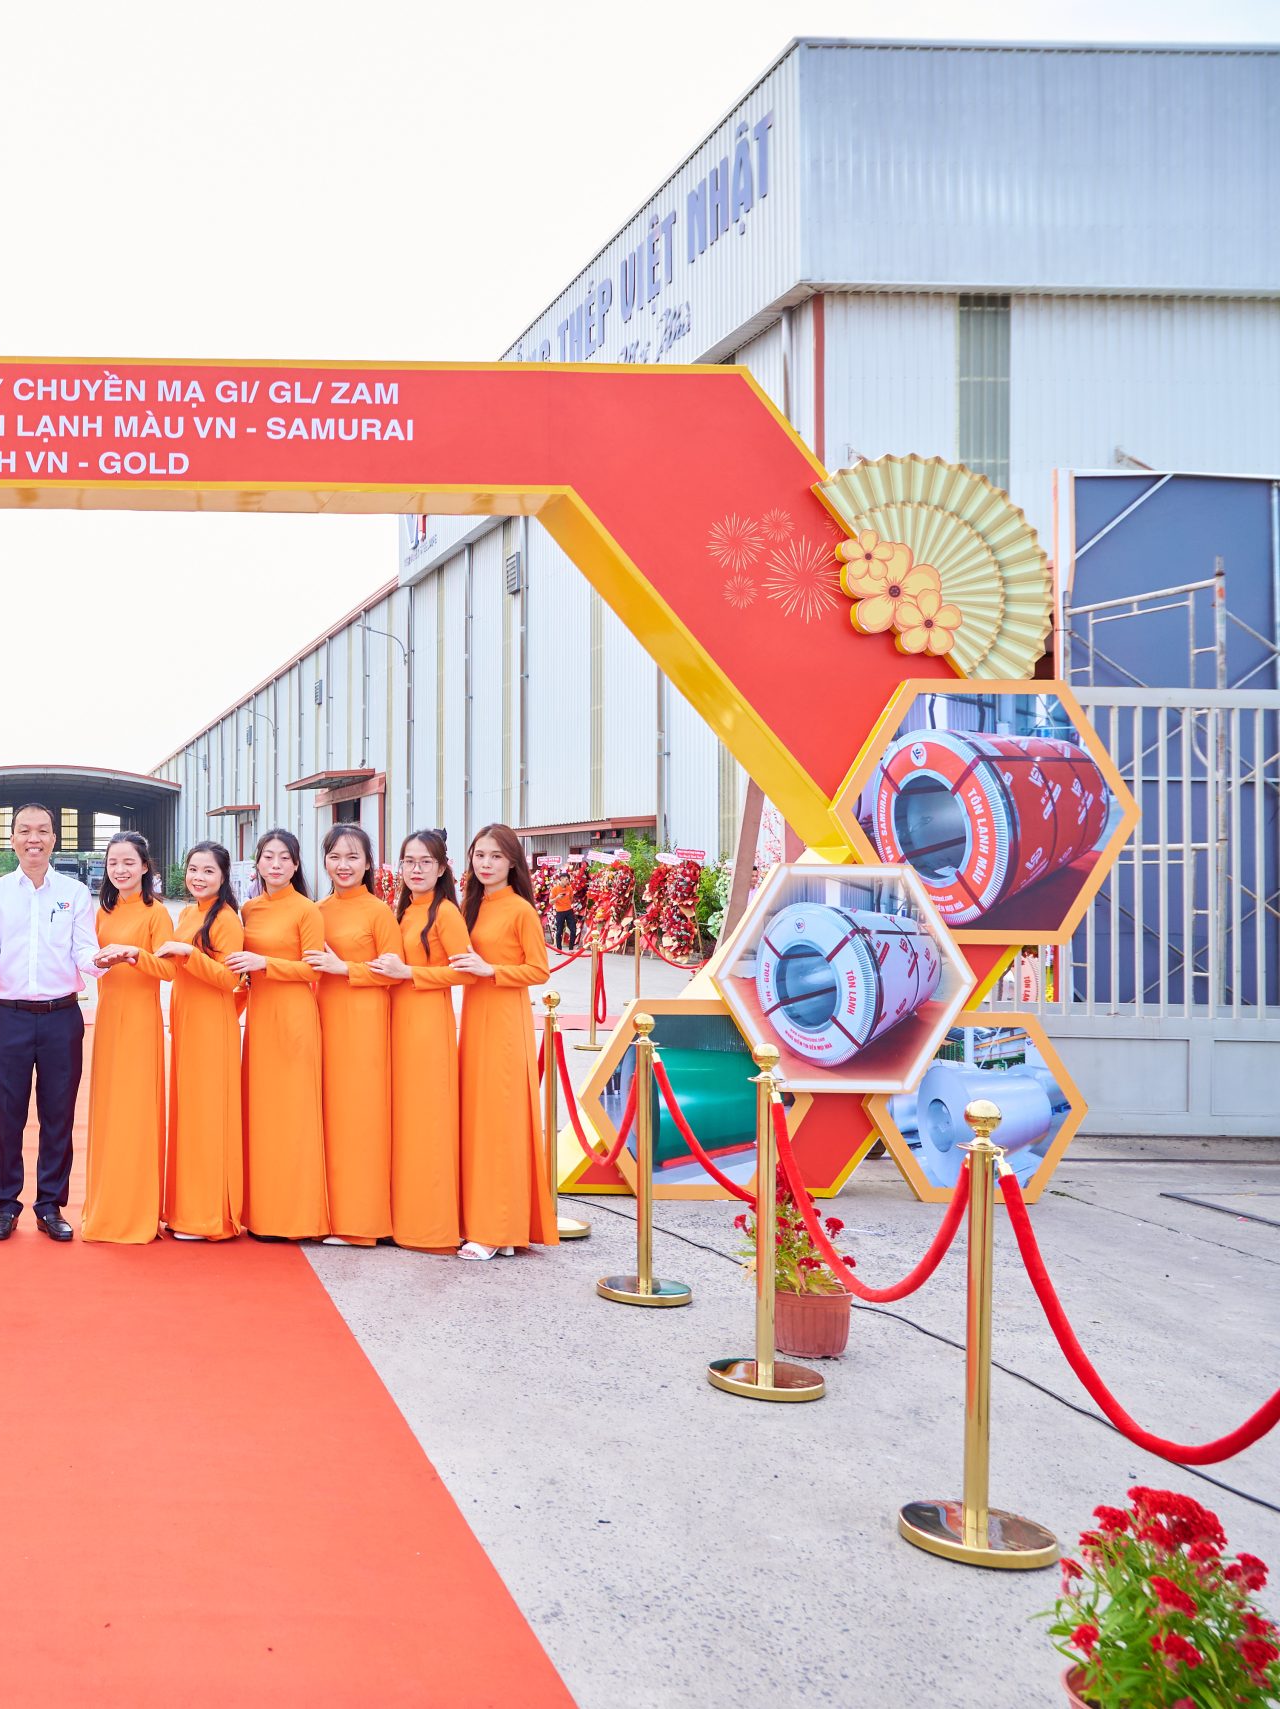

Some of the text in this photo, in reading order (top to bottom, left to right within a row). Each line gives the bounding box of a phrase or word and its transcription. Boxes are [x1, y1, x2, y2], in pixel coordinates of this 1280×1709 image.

[620, 209, 676, 323] VIỆT
[687, 109, 774, 264] NHẬT
[13, 371, 145, 402] CHUYỀN
[158, 380, 205, 408] MẠ
[215, 381, 258, 404] GI/
[268, 381, 322, 404] GL/
[330, 382, 399, 405] ZAM
[17, 415, 102, 443] LẠNH
[114, 410, 184, 439] MÀU
[193, 416, 236, 439] VN
[266, 416, 414, 441] SAMURAI
[25, 451, 68, 473] VN
[98, 451, 189, 475] GOLD
[879, 790, 888, 836] SAMURAI
[968, 787, 984, 815] TÔN
[977, 817, 990, 855] LẠNH
[972, 856, 989, 885] MÀU
[845, 970, 856, 989] TÔN
